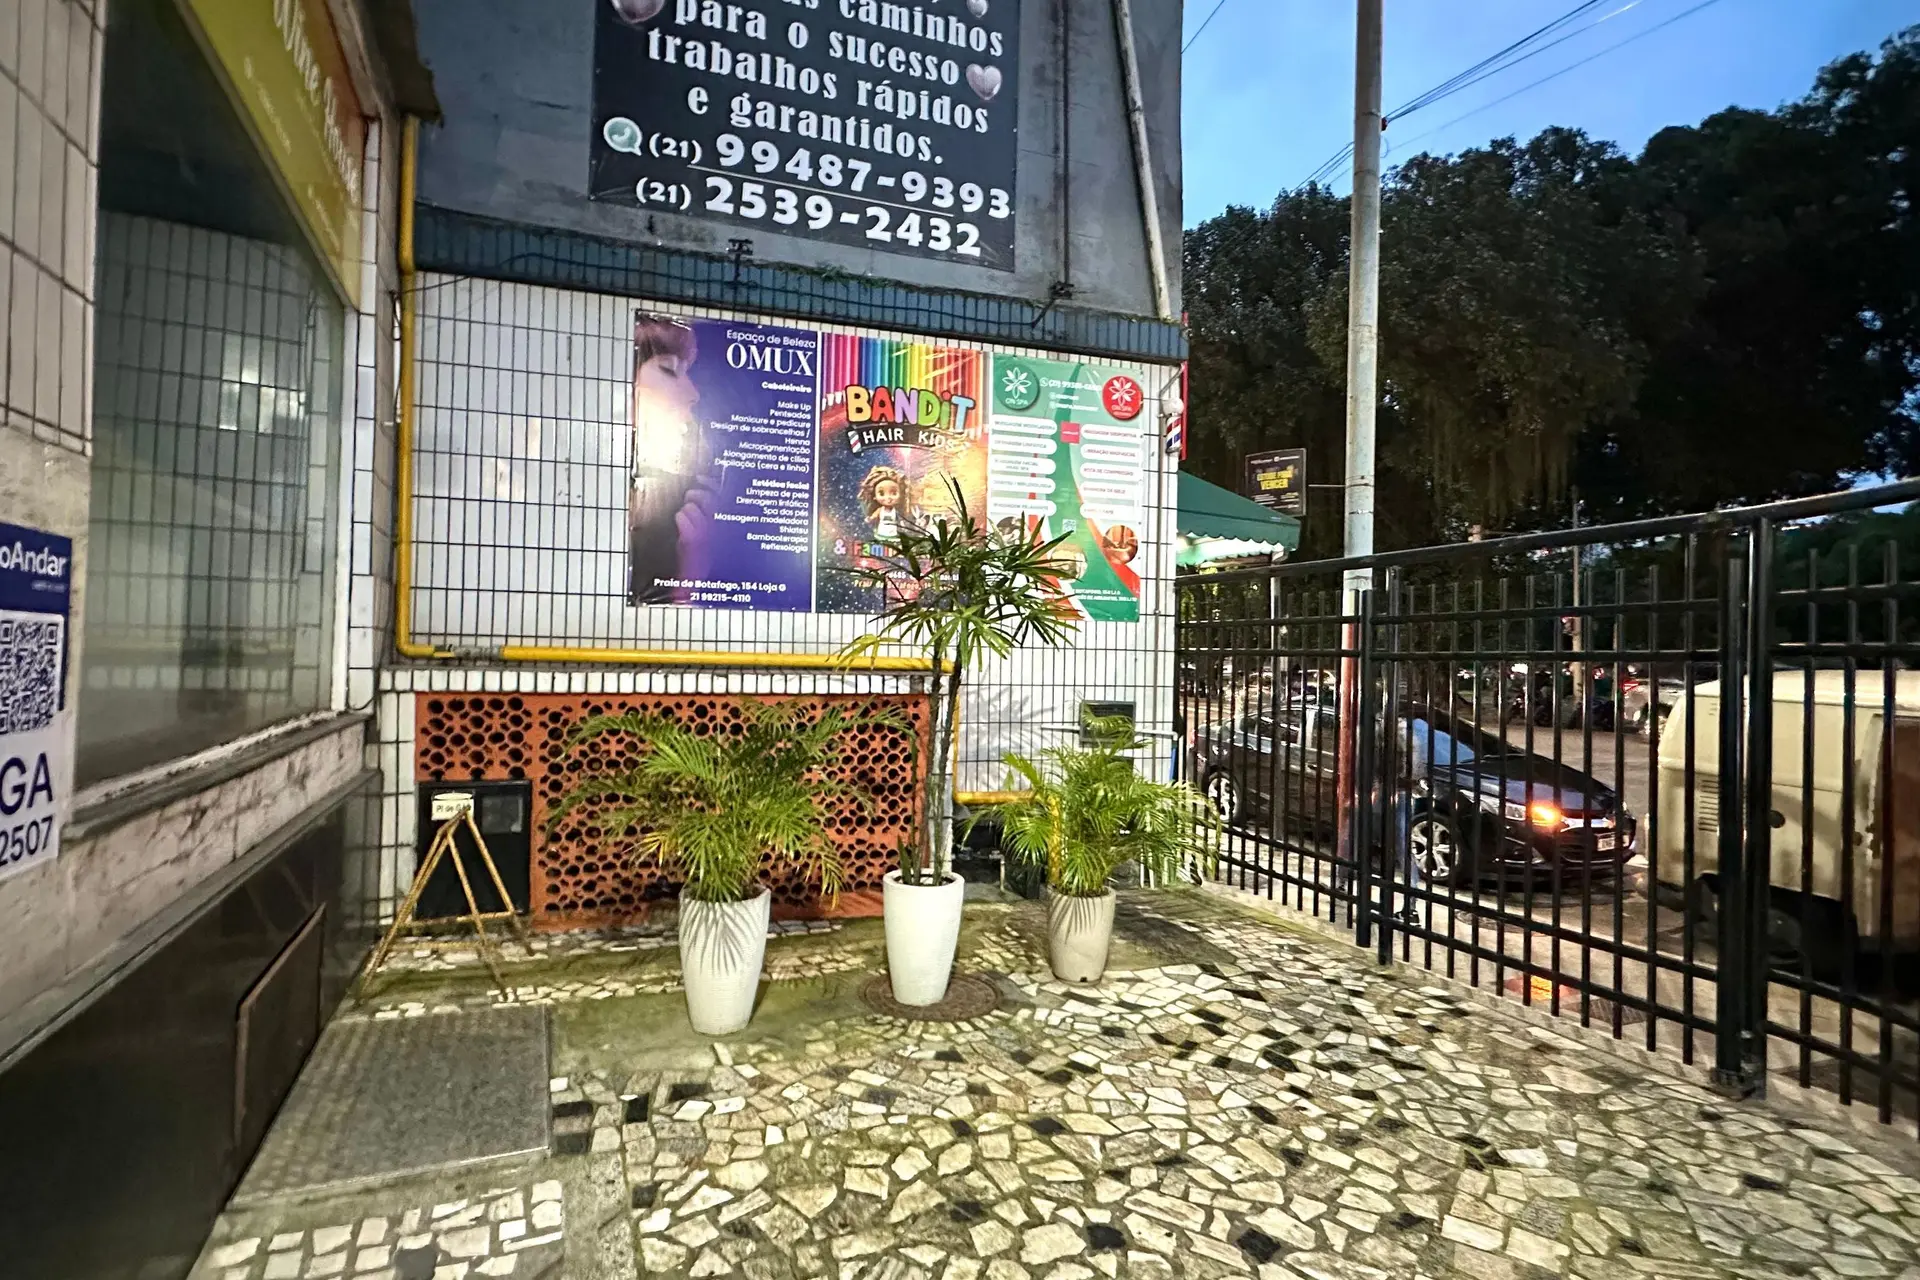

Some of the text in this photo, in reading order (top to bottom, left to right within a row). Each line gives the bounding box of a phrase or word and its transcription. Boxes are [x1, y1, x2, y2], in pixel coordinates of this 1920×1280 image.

[840, 0, 1003, 57] caminhos
[675, 0, 960, 85] para o sucesso
[648, 27, 990, 134] trabalhos rápidos
[687, 86, 944, 165] e garantidos.
[648, 133, 1011, 219] (21) 99487-9393
[635, 176, 983, 257] (21) 2539-2432
[726, 329, 816, 349] Espaço de Beleza
[726, 342, 815, 377] OMUX
[777, 401, 811, 411] Make Up
[731, 414, 768, 424] Manicure
[776, 420, 811, 429] pedicure
[770, 409, 811, 420] Penteados
[710, 421, 738, 432] Design
[740, 424, 751, 432] de
[752, 426, 805, 437] sobrancelhas
[785, 437, 811, 446] Henna
[863, 429, 905, 445] HAIR
[918, 430, 960, 451] KIDS
[723, 449, 777, 461] Alongamento
[778, 453, 789, 462] de
[757, 460, 779, 470] (cera
[746, 488, 810, 499] Limpeza de pele
[736, 496, 778, 507] Drenagem
[714, 512, 809, 525] Massagem modeladora
[763, 507, 778, 516] Spa
[779, 526, 809, 534] Shiatsu
[761, 542, 808, 553] Reflexologia
[833, 538, 847, 555] &
[653, 578, 679, 588] Praia
[681, 578, 694, 588] de
[694, 579, 741, 592] Botafogo,
[741, 581, 758, 591] 154
[758, 582, 777, 594] Loja
[690, 592, 700, 601] 21
